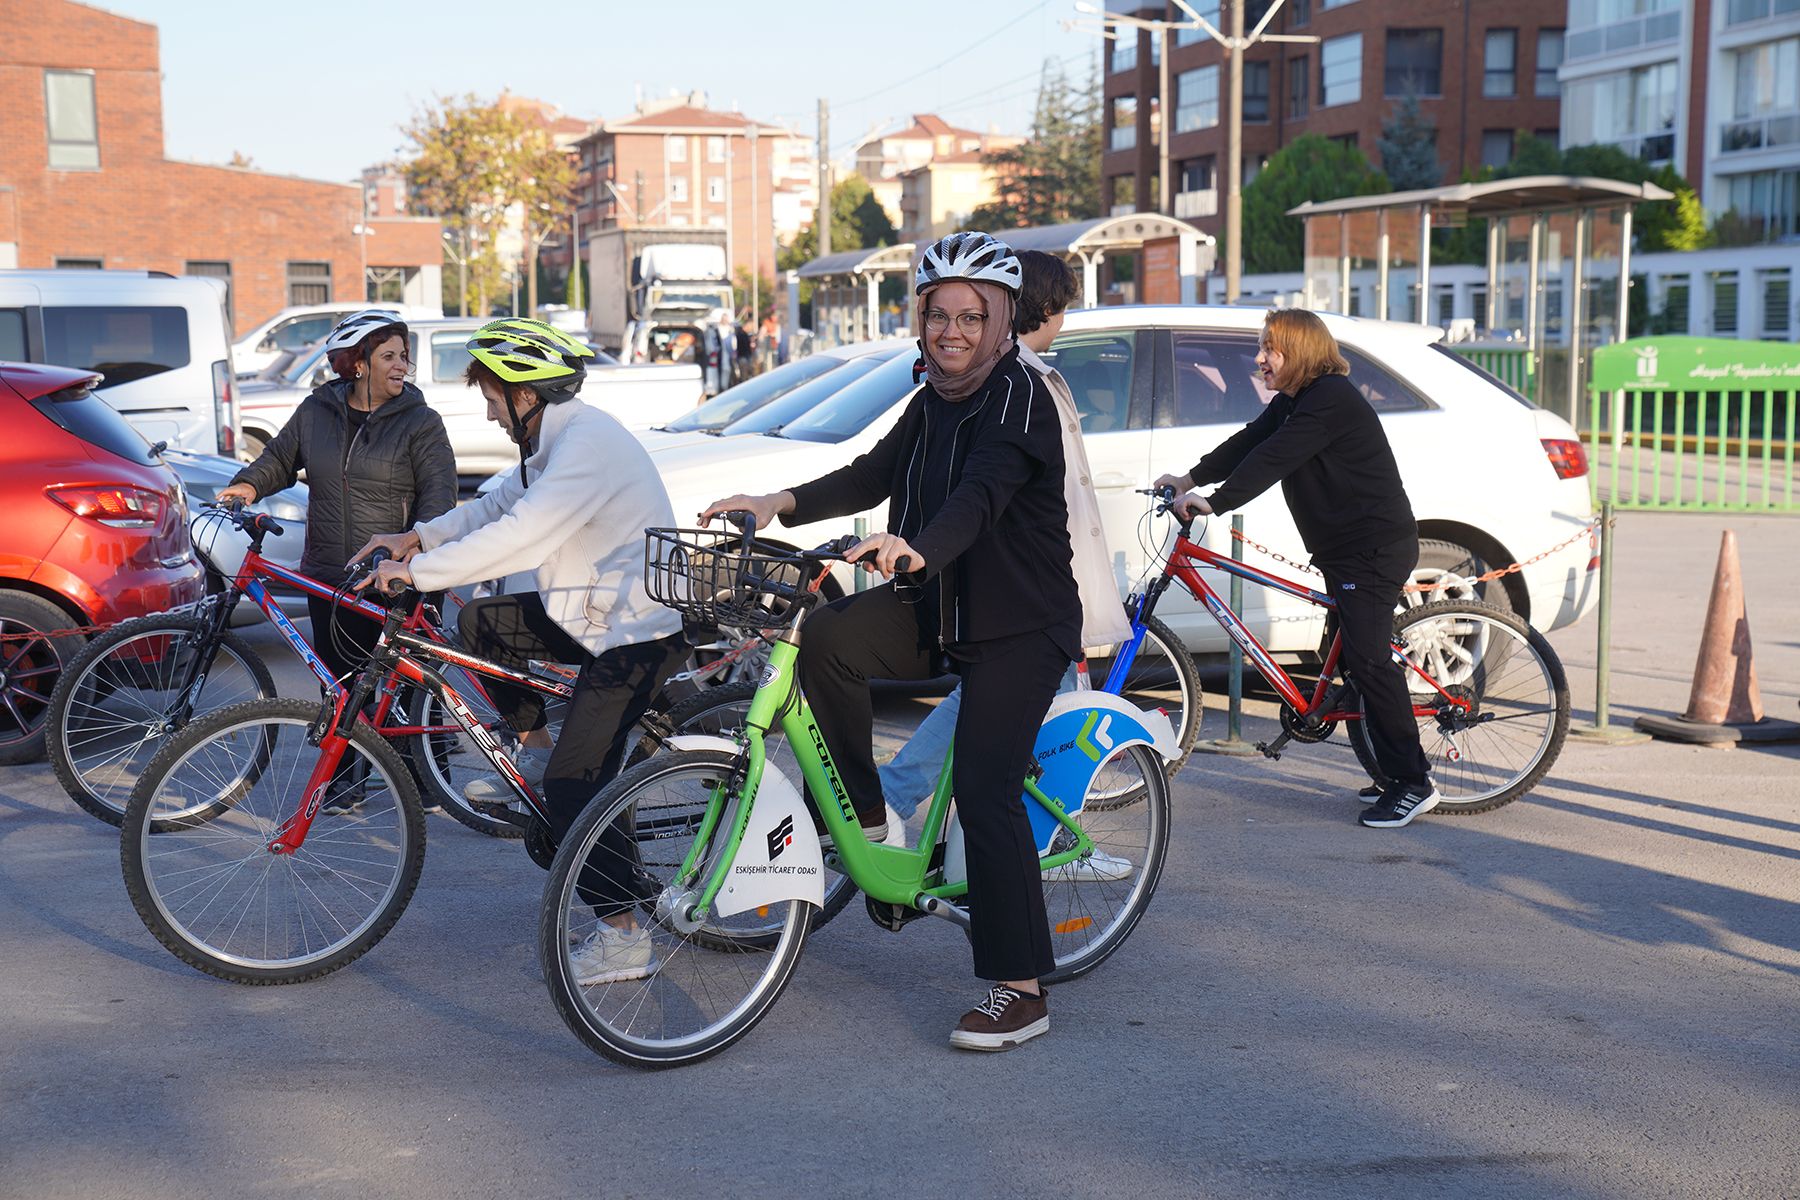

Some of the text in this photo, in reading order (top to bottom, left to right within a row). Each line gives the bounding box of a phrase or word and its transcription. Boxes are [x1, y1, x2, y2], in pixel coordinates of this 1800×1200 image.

[453, 696, 522, 781] TEC
[1038, 740, 1075, 760] FOLK BIKE
[808, 724, 856, 823] corelli
[735, 864, 817, 875] ESKİŞEHİR TİCARET ODASI
